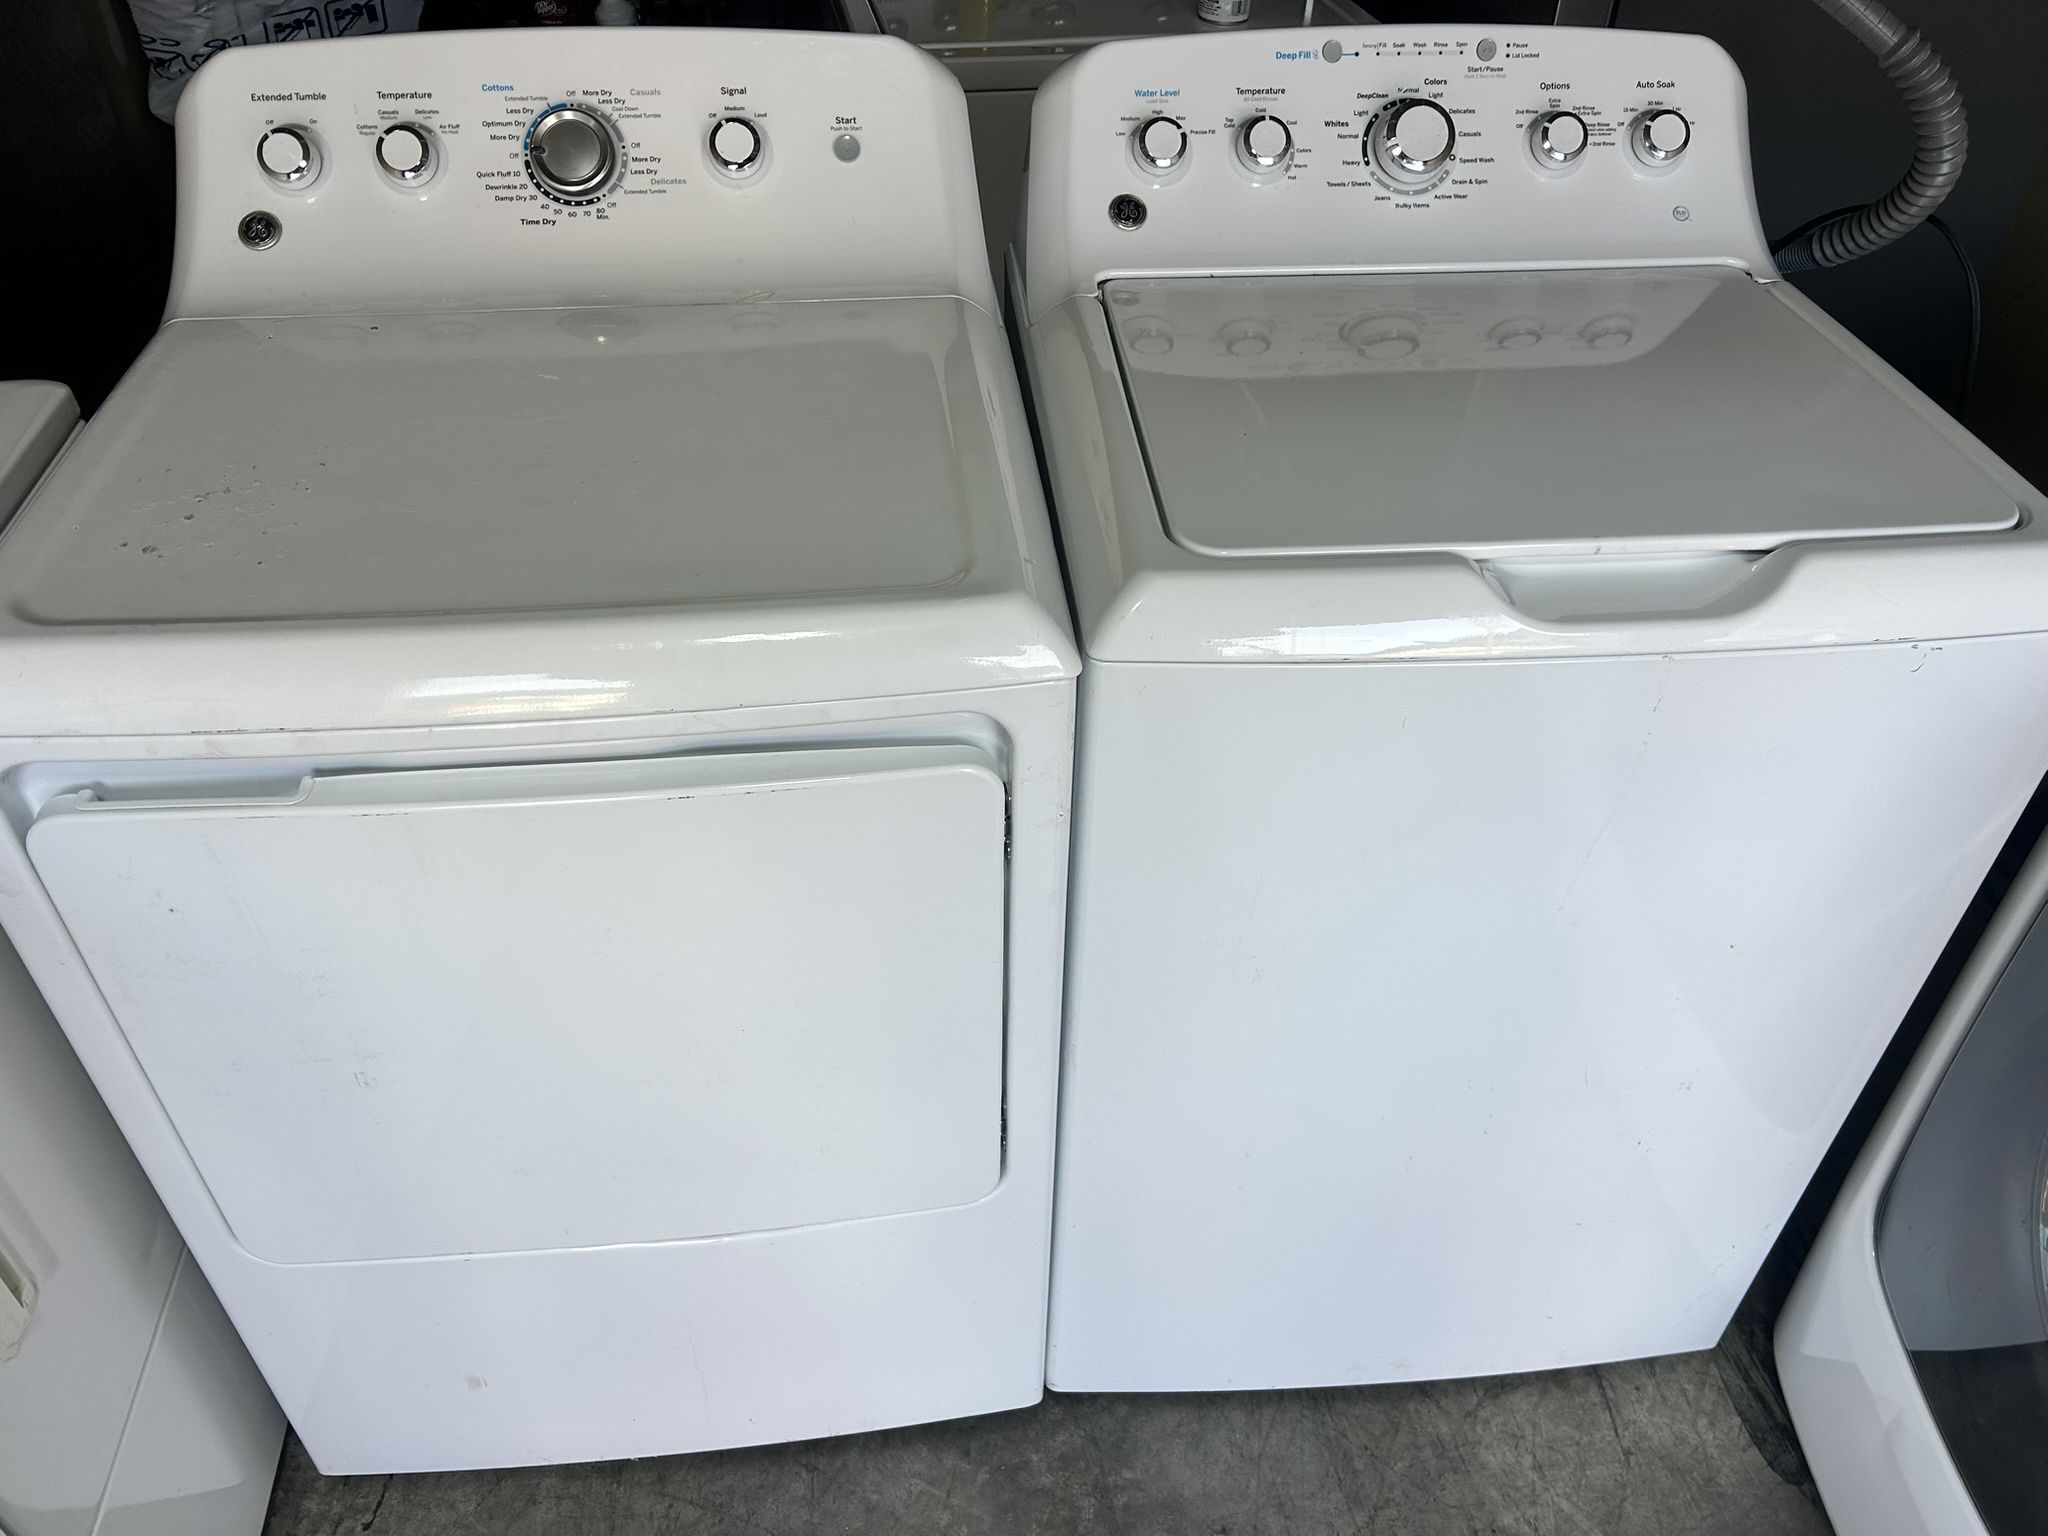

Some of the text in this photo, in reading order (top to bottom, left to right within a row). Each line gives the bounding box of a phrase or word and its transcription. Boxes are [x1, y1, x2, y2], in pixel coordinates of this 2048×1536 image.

[1275, 51, 1311, 60] Deep Fill
[481, 84, 514, 92] Cottons
[1540, 82, 1571, 91] Options
[1656, 80, 1676, 88] Soak
[720, 86, 747, 96] Signal
[1135, 89, 1180, 97] Water Level
[1236, 88, 1286, 96] Temperature
[251, 92, 327, 101] Extended Tumble
[377, 91, 433, 100] Temperature
[1356, 92, 1389, 100] DeepClean
[514, 120, 526, 128] Dry
[835, 116, 857, 124] Start
[476, 171, 495, 179] Quick
[542, 218, 557, 226] Dry
